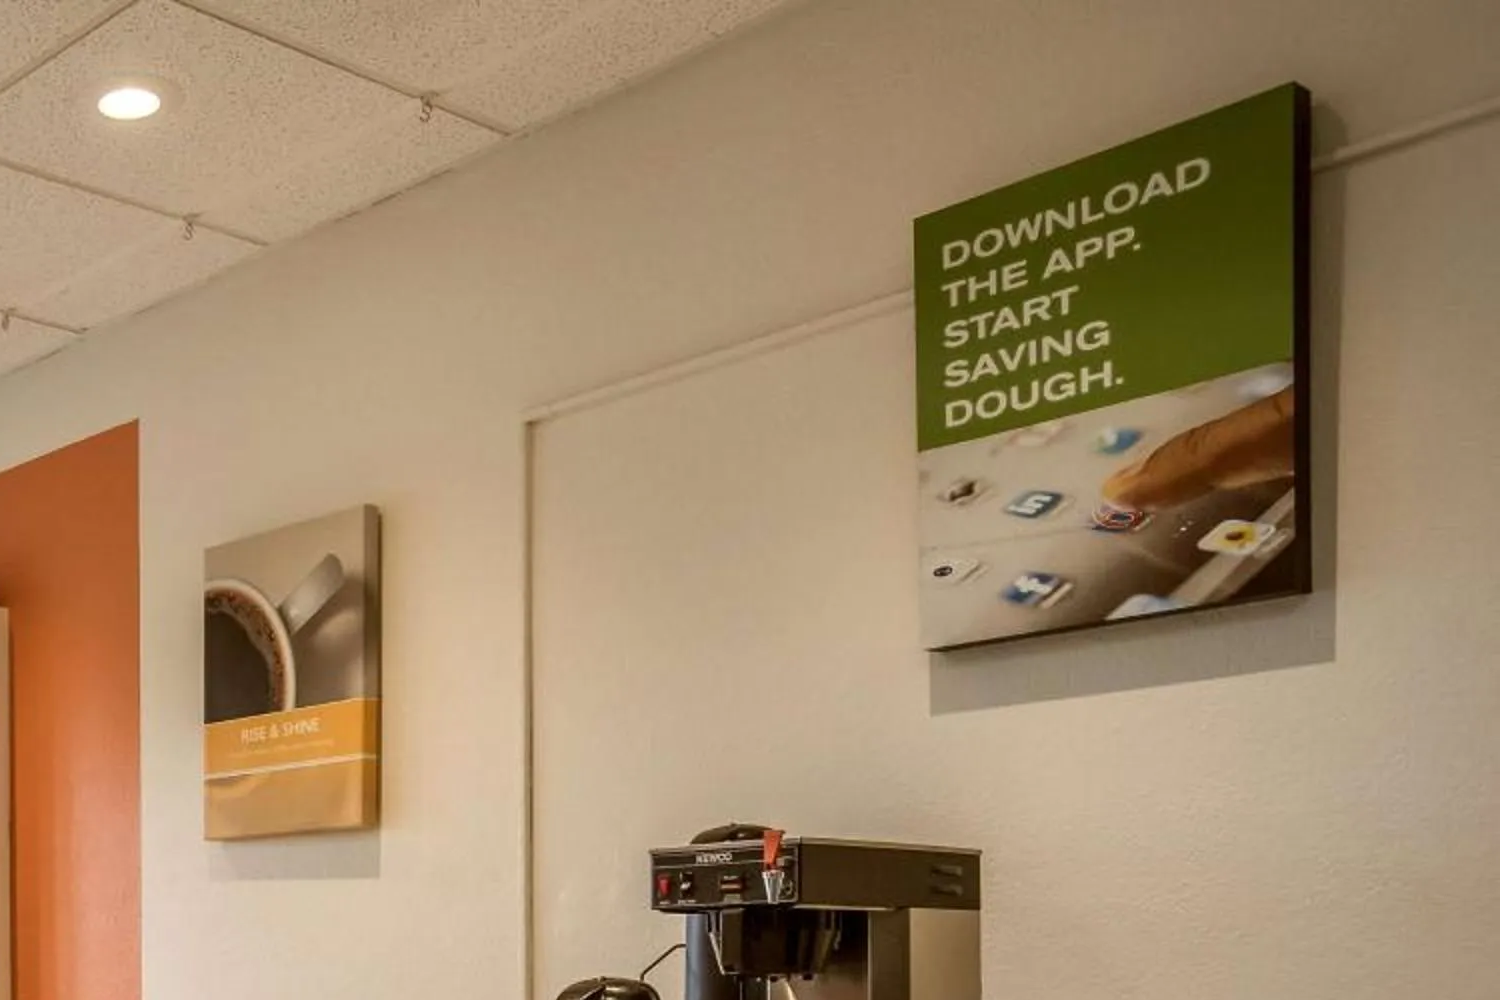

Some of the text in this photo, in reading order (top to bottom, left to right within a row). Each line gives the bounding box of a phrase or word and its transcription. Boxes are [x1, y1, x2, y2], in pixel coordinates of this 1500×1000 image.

[941, 157, 1211, 270] DOWNLOAD
[941, 225, 1142, 308] THE APP.
[943, 284, 1080, 349] START
[943, 319, 1111, 388] SAVING
[945, 359, 1125, 428] DOUGH.
[240, 725, 267, 745] RISE
[280, 716, 321, 738] SHINE
